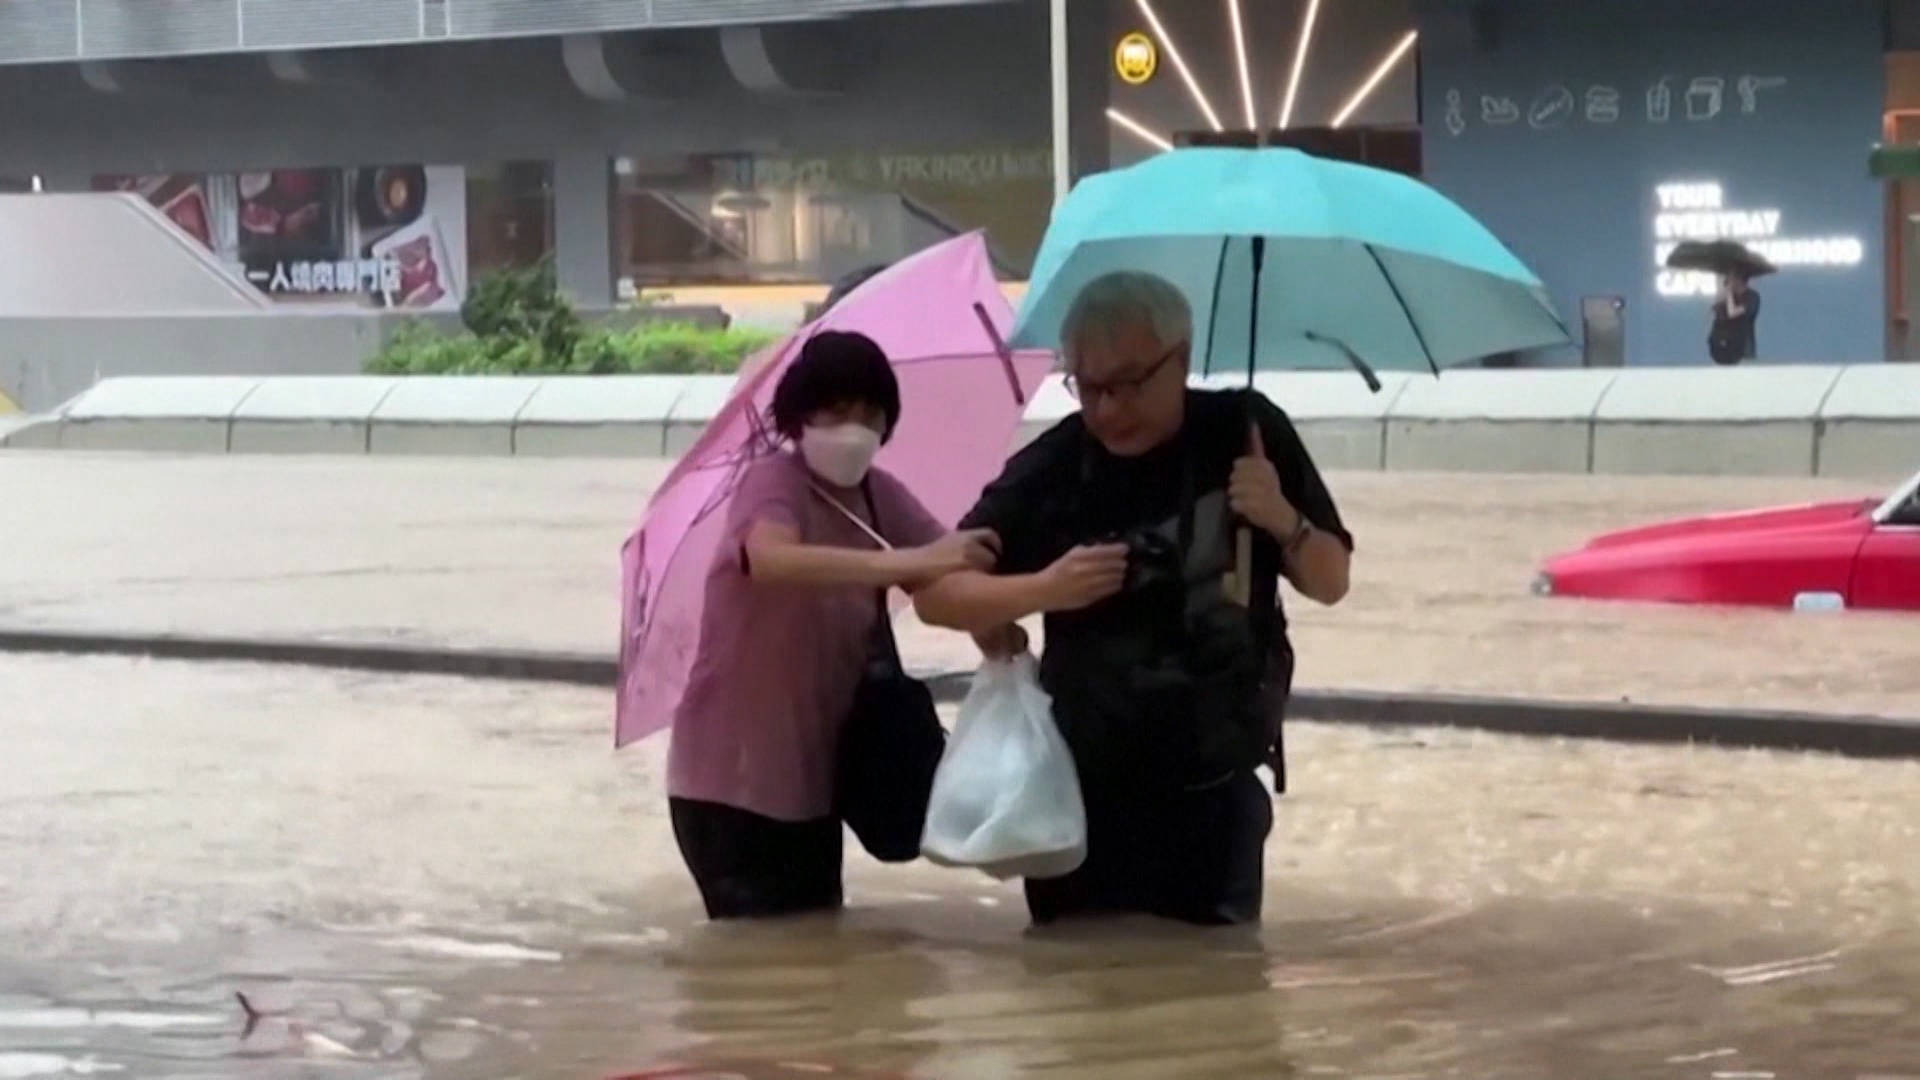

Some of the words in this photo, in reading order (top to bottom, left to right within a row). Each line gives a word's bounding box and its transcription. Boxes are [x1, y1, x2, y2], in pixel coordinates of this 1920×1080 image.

[1656, 184, 1722, 208] YOUR
[1656, 210, 1780, 237] EVERYDAY
[241, 260, 402, 292] 一人燒肉專門店
